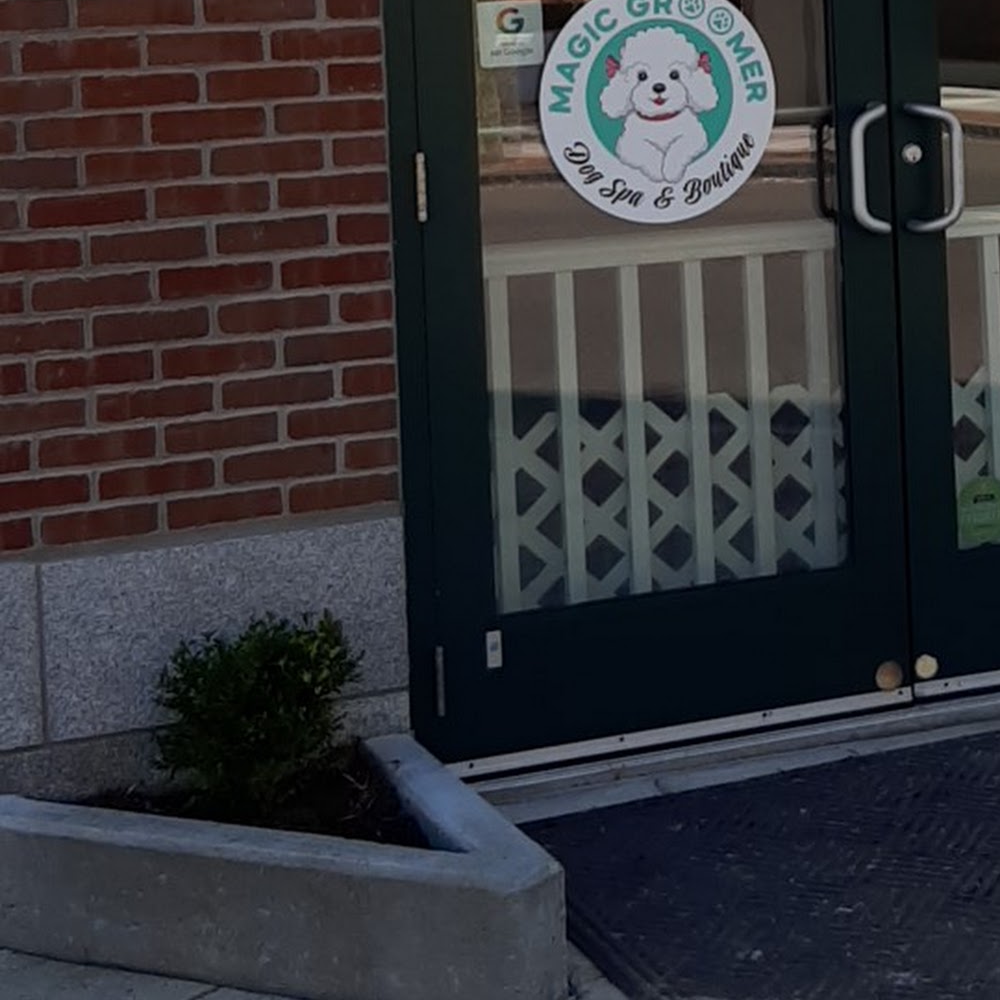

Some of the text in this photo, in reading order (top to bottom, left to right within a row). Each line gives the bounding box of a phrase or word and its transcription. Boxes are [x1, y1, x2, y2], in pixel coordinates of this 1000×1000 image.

[548, 8, 618, 114] MAGIC
[563, 132, 756, 210] Dog Spa & Boutique
